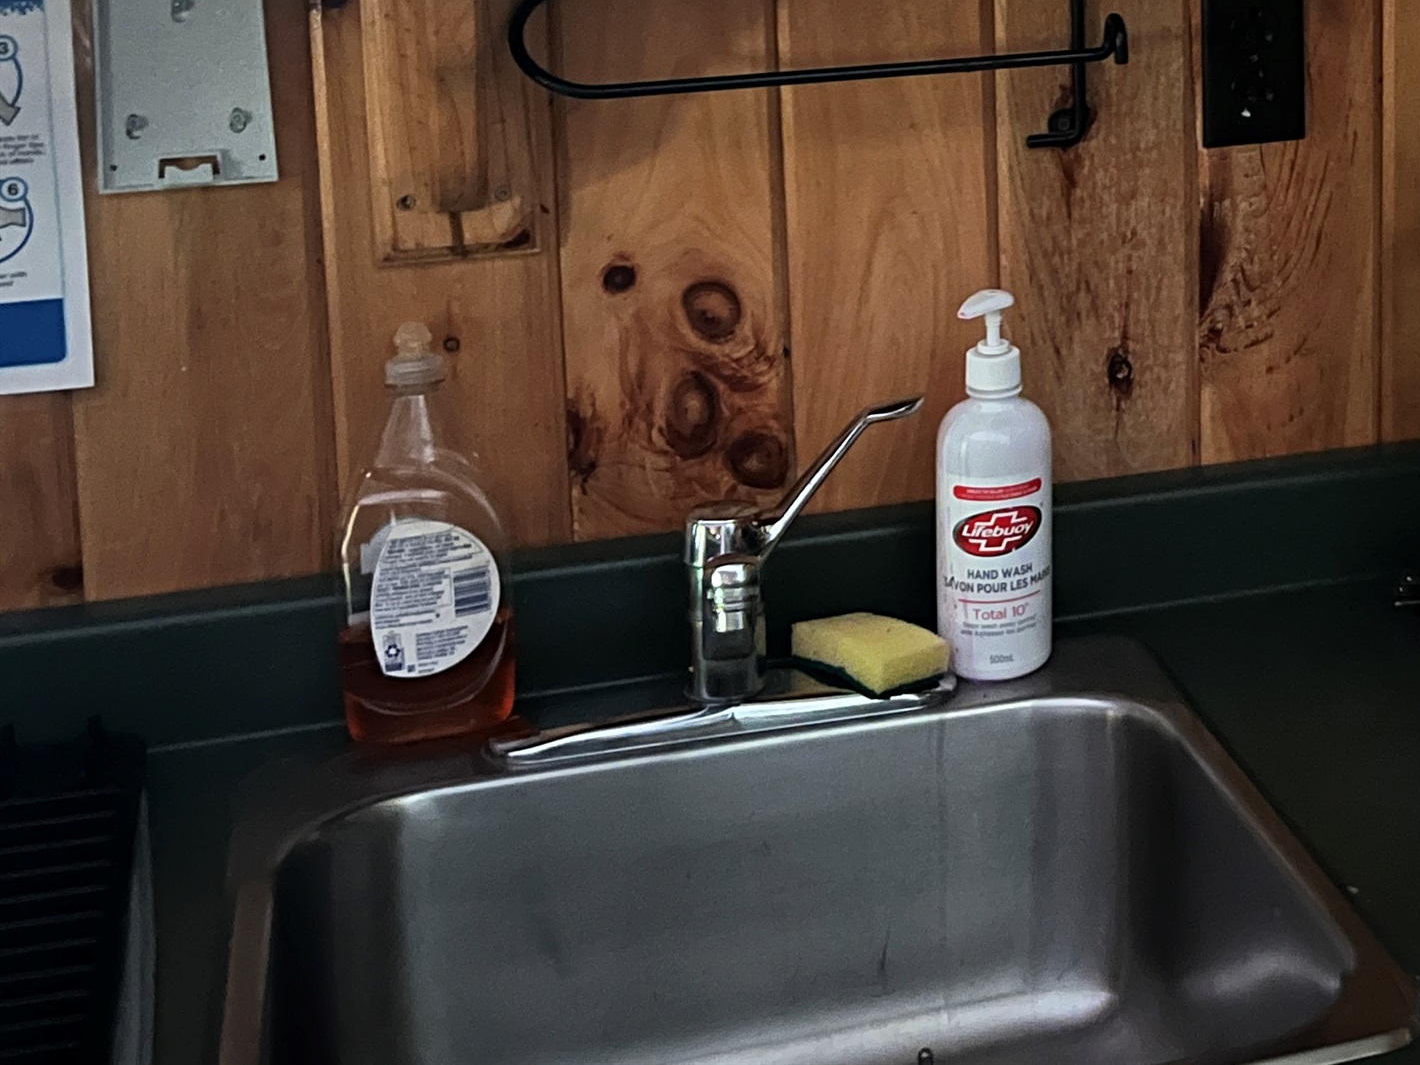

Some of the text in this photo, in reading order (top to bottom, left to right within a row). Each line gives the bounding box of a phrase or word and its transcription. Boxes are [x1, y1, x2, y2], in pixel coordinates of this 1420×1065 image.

[8, 183, 19, 196] 6
[961, 520, 1034, 538] Lifebuoy
[966, 562, 1033, 581] HAND WASH
[976, 581, 1008, 594] POUR
[1010, 577, 1029, 591] LES
[973, 607, 1007, 621] Total
